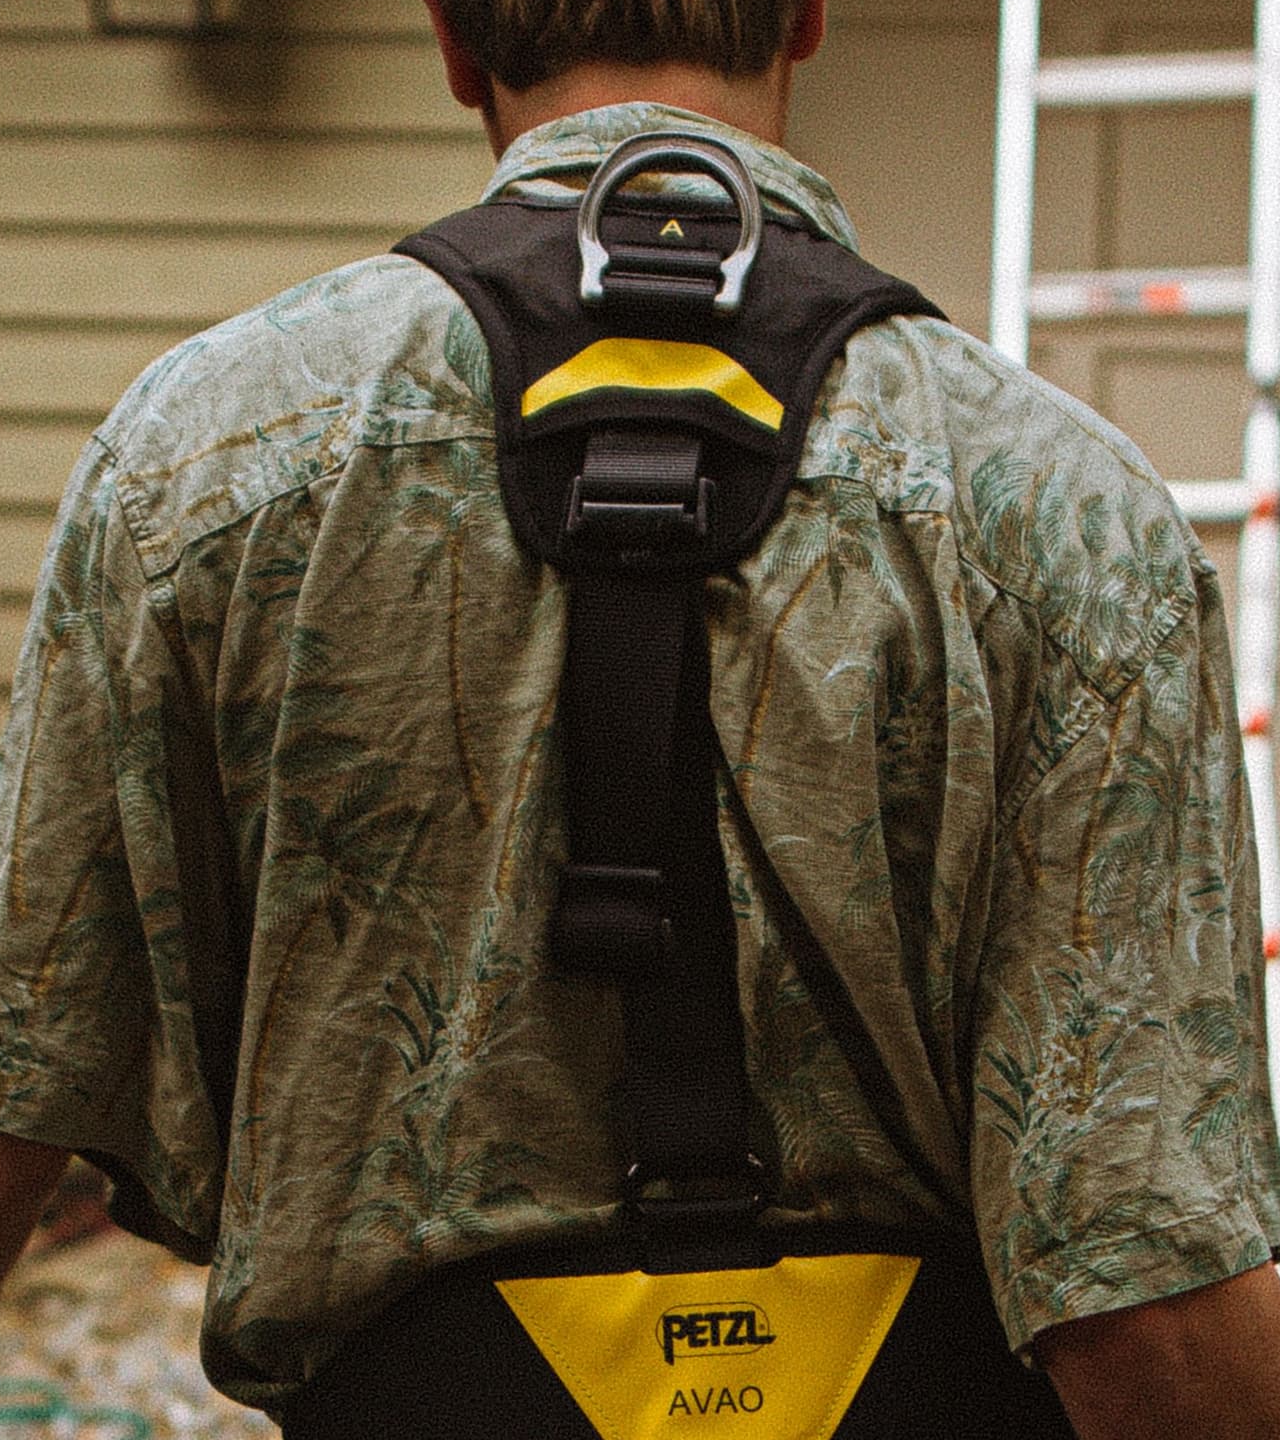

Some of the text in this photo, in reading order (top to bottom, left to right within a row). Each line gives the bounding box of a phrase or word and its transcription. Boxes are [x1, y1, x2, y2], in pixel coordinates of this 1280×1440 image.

[659, 218, 685, 238] A
[663, 1310, 776, 1366] PETZL
[668, 1385, 764, 1416] AVAO
